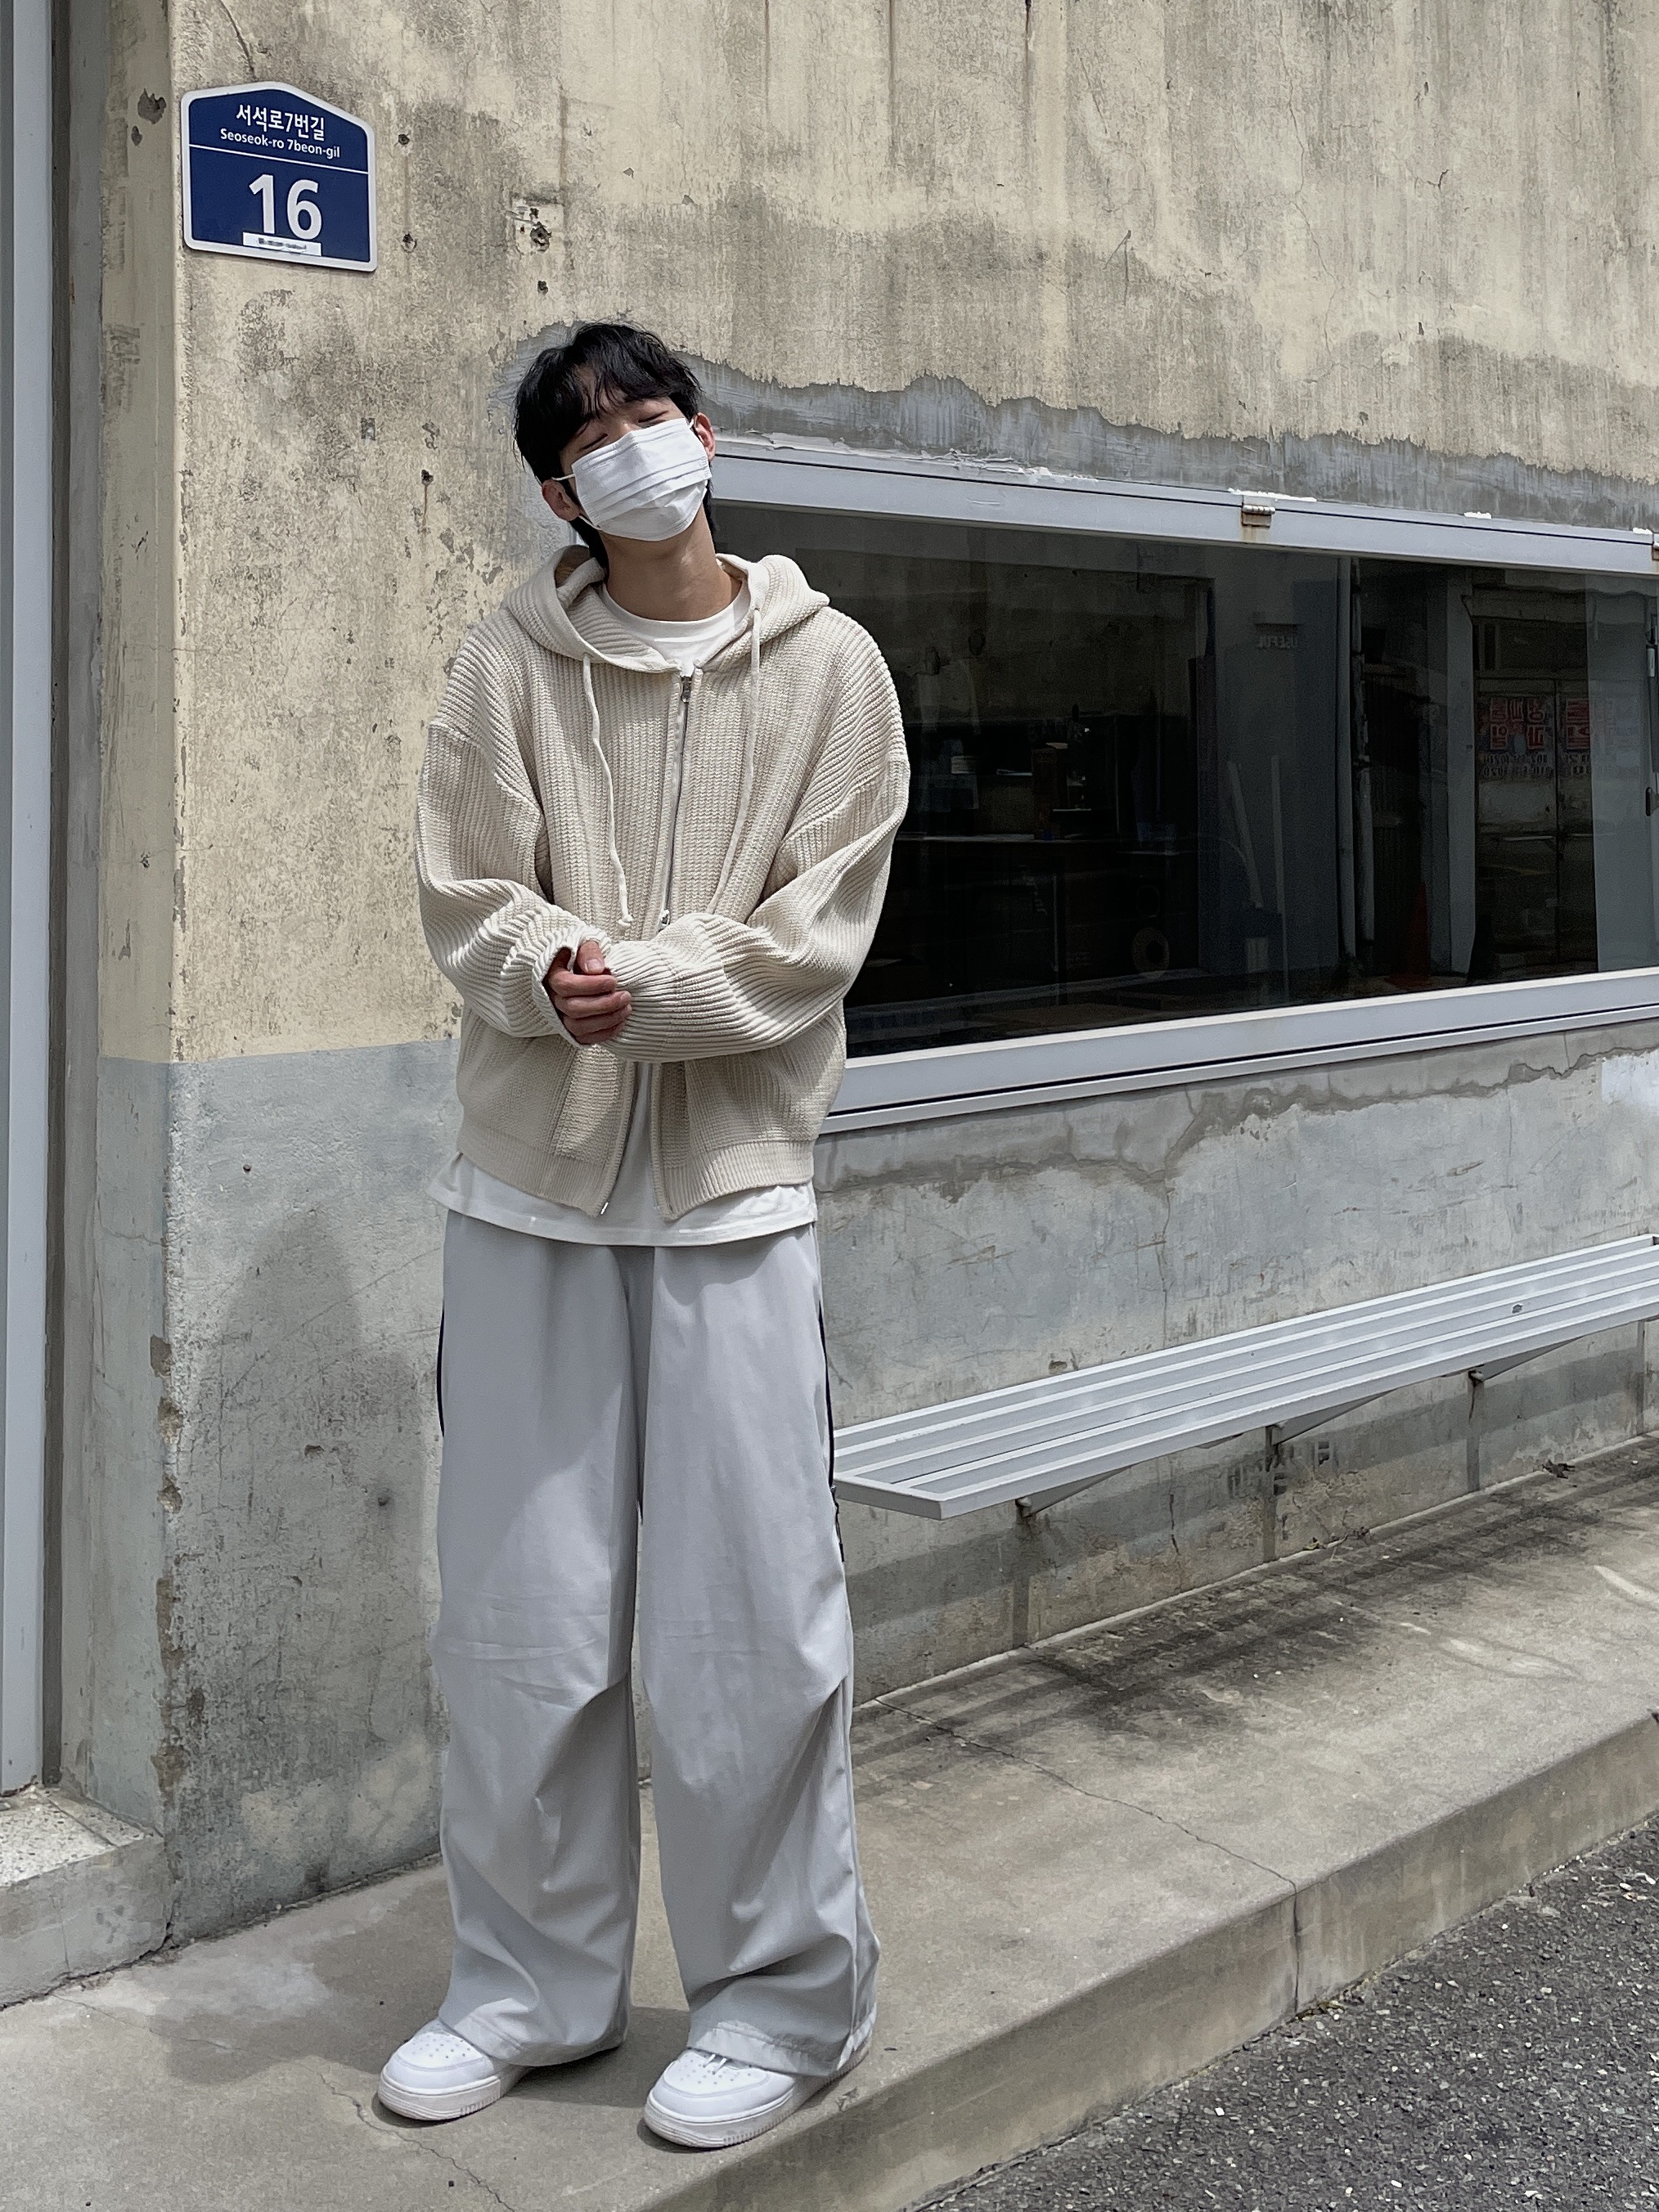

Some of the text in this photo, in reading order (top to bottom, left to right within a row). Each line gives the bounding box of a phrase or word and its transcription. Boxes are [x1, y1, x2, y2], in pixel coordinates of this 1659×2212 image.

[236, 104, 326, 142] 서석로7번길
[220, 128, 340, 159] Seoseok-ro 7beon-gil
[248, 173, 322, 240] 16
